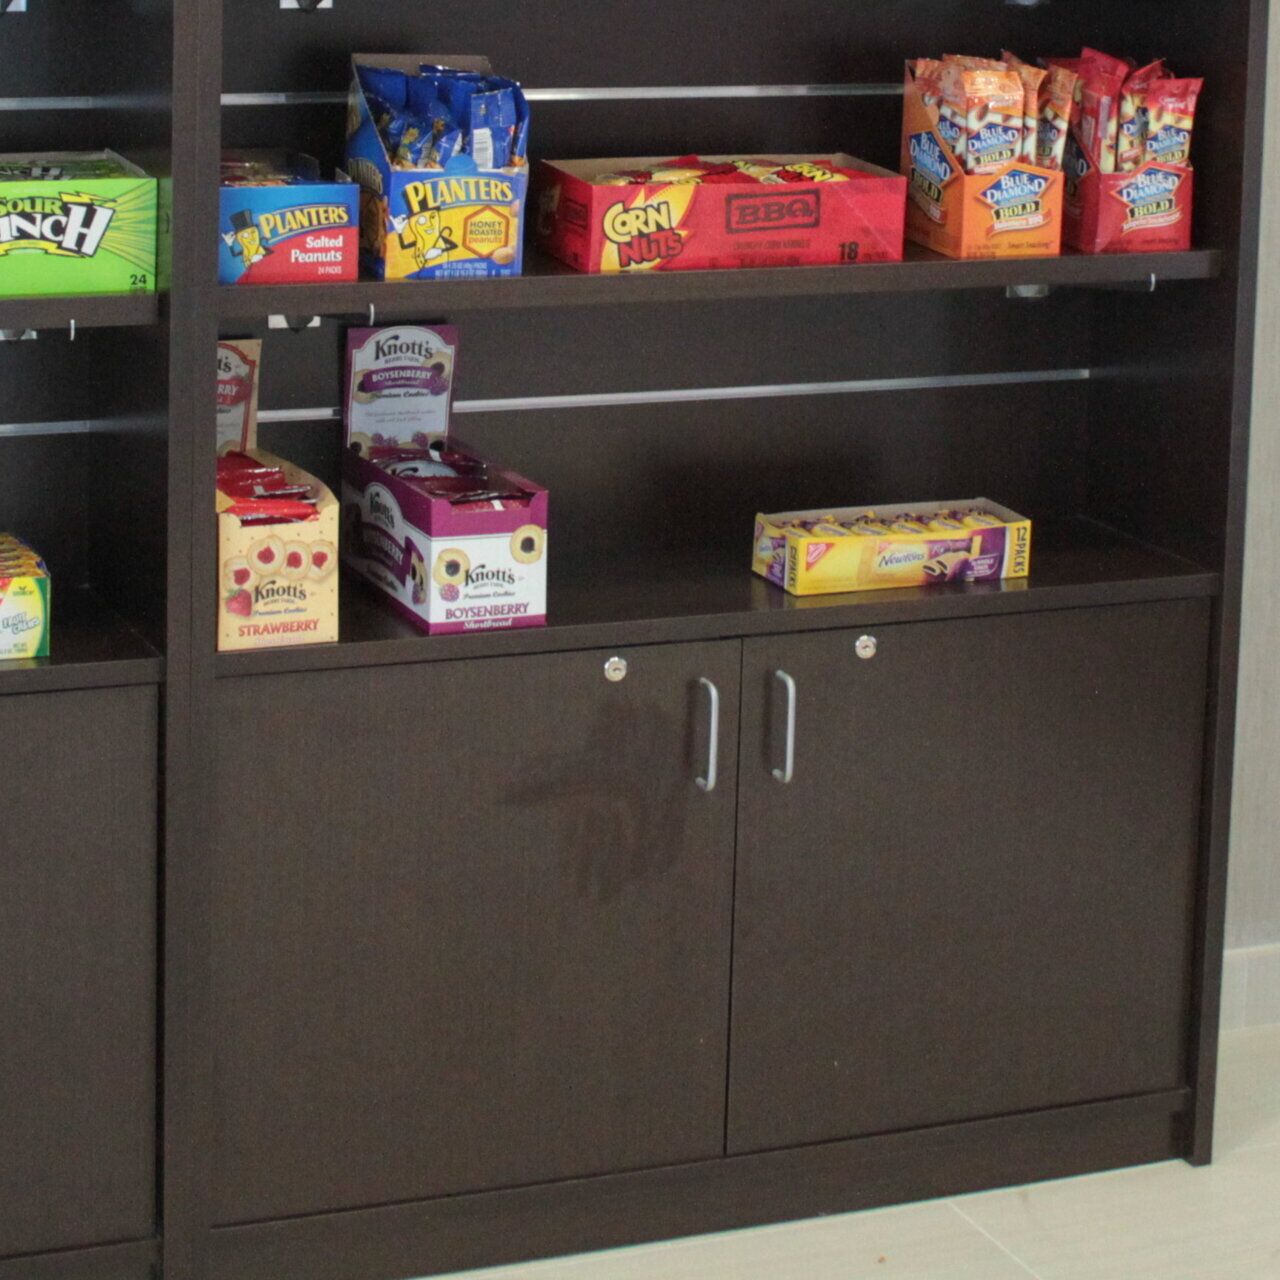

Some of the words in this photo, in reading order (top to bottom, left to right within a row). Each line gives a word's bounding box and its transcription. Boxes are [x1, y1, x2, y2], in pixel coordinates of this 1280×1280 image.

[969, 130, 1018, 151] DIAMOND
[979, 126, 1004, 140] BLUE
[921, 132, 940, 160] BLUE
[979, 150, 1011, 163] BOLD
[1001, 173, 1030, 188] BLUE
[1123, 176, 1179, 201] DIAMOND
[405, 178, 513, 211] PLANTERS
[986, 179, 1045, 202] DIAMOND
[734, 200, 812, 226] BBQ
[999, 202, 1036, 218] BOLD
[1134, 200, 1169, 217] BOLD
[258, 206, 349, 238] PLANTERS
[470, 221, 503, 229] HONEY
[603, 201, 671, 244] CORN
[305, 236, 344, 249] Salted
[619, 232, 684, 267] NUTS
[838, 242, 860, 261] 18
[290, 250, 343, 264] Peanuts
[129, 274, 147, 286] 24
[374, 335, 434, 362] Knott's
[371, 368, 433, 383] BOYSENBERRY
[877, 552, 925, 568] Newtons
[1012, 543, 1027, 574] PACKS
[464, 565, 515, 586] Knott's
[253, 580, 307, 603] Knott's
[445, 602, 530, 620] BOYSENBERRY
[238, 620, 319, 639] STRAWBERRY
[463, 618, 513, 631] Shortbread
